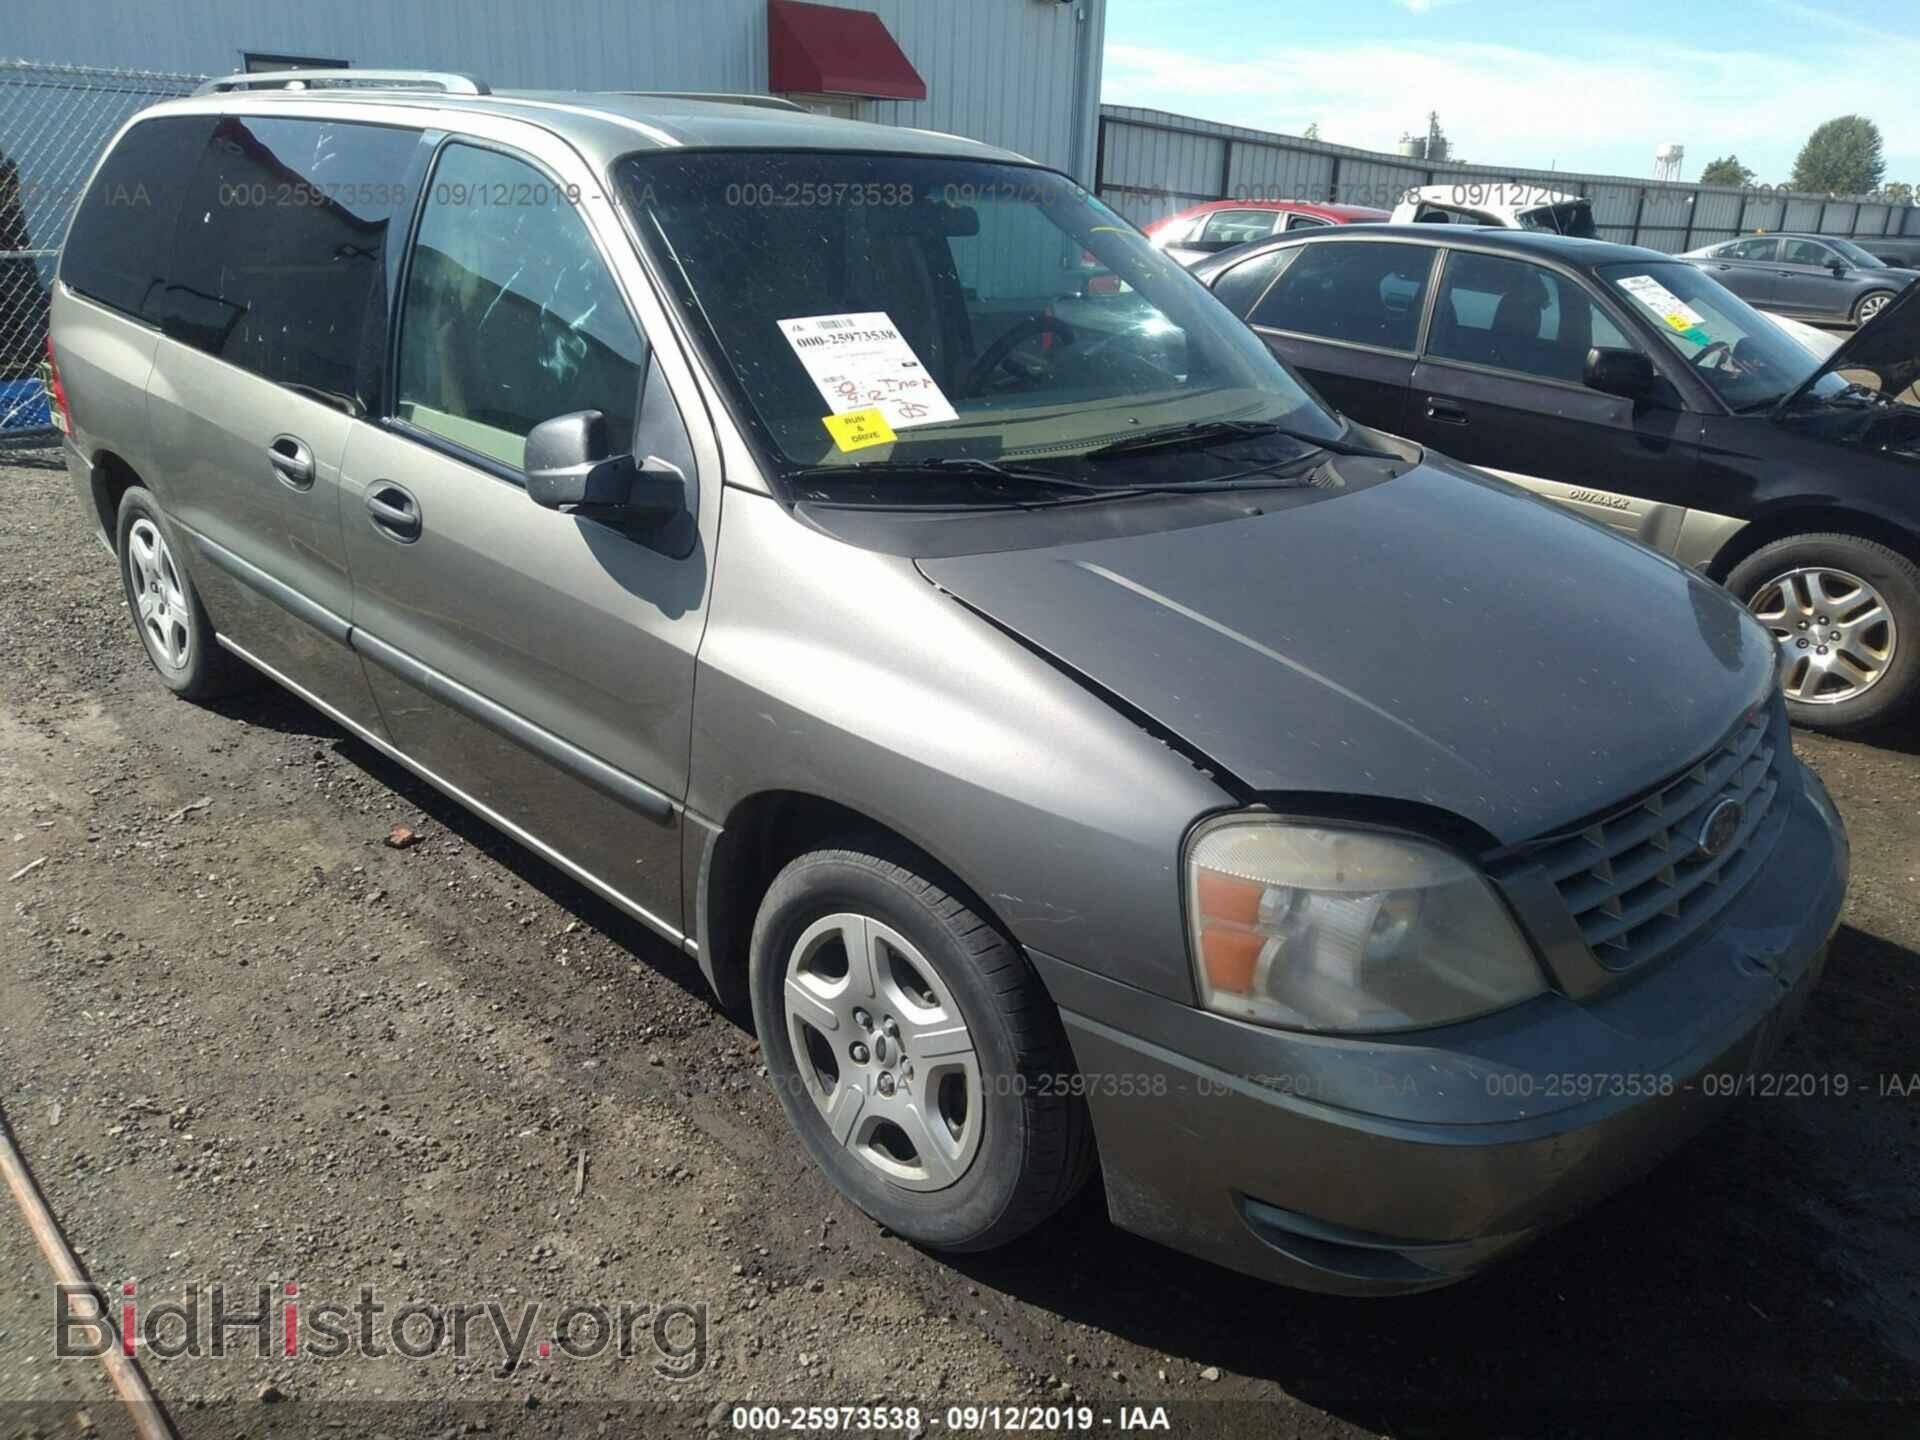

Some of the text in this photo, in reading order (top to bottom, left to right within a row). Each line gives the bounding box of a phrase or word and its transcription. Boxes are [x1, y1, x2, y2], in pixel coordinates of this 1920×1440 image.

[796, 329, 897, 348] 000-25973538
[844, 415, 865, 425] RUN
[851, 431, 881, 442] DRIVE
[1569, 488, 1630, 510] OUTBACK
